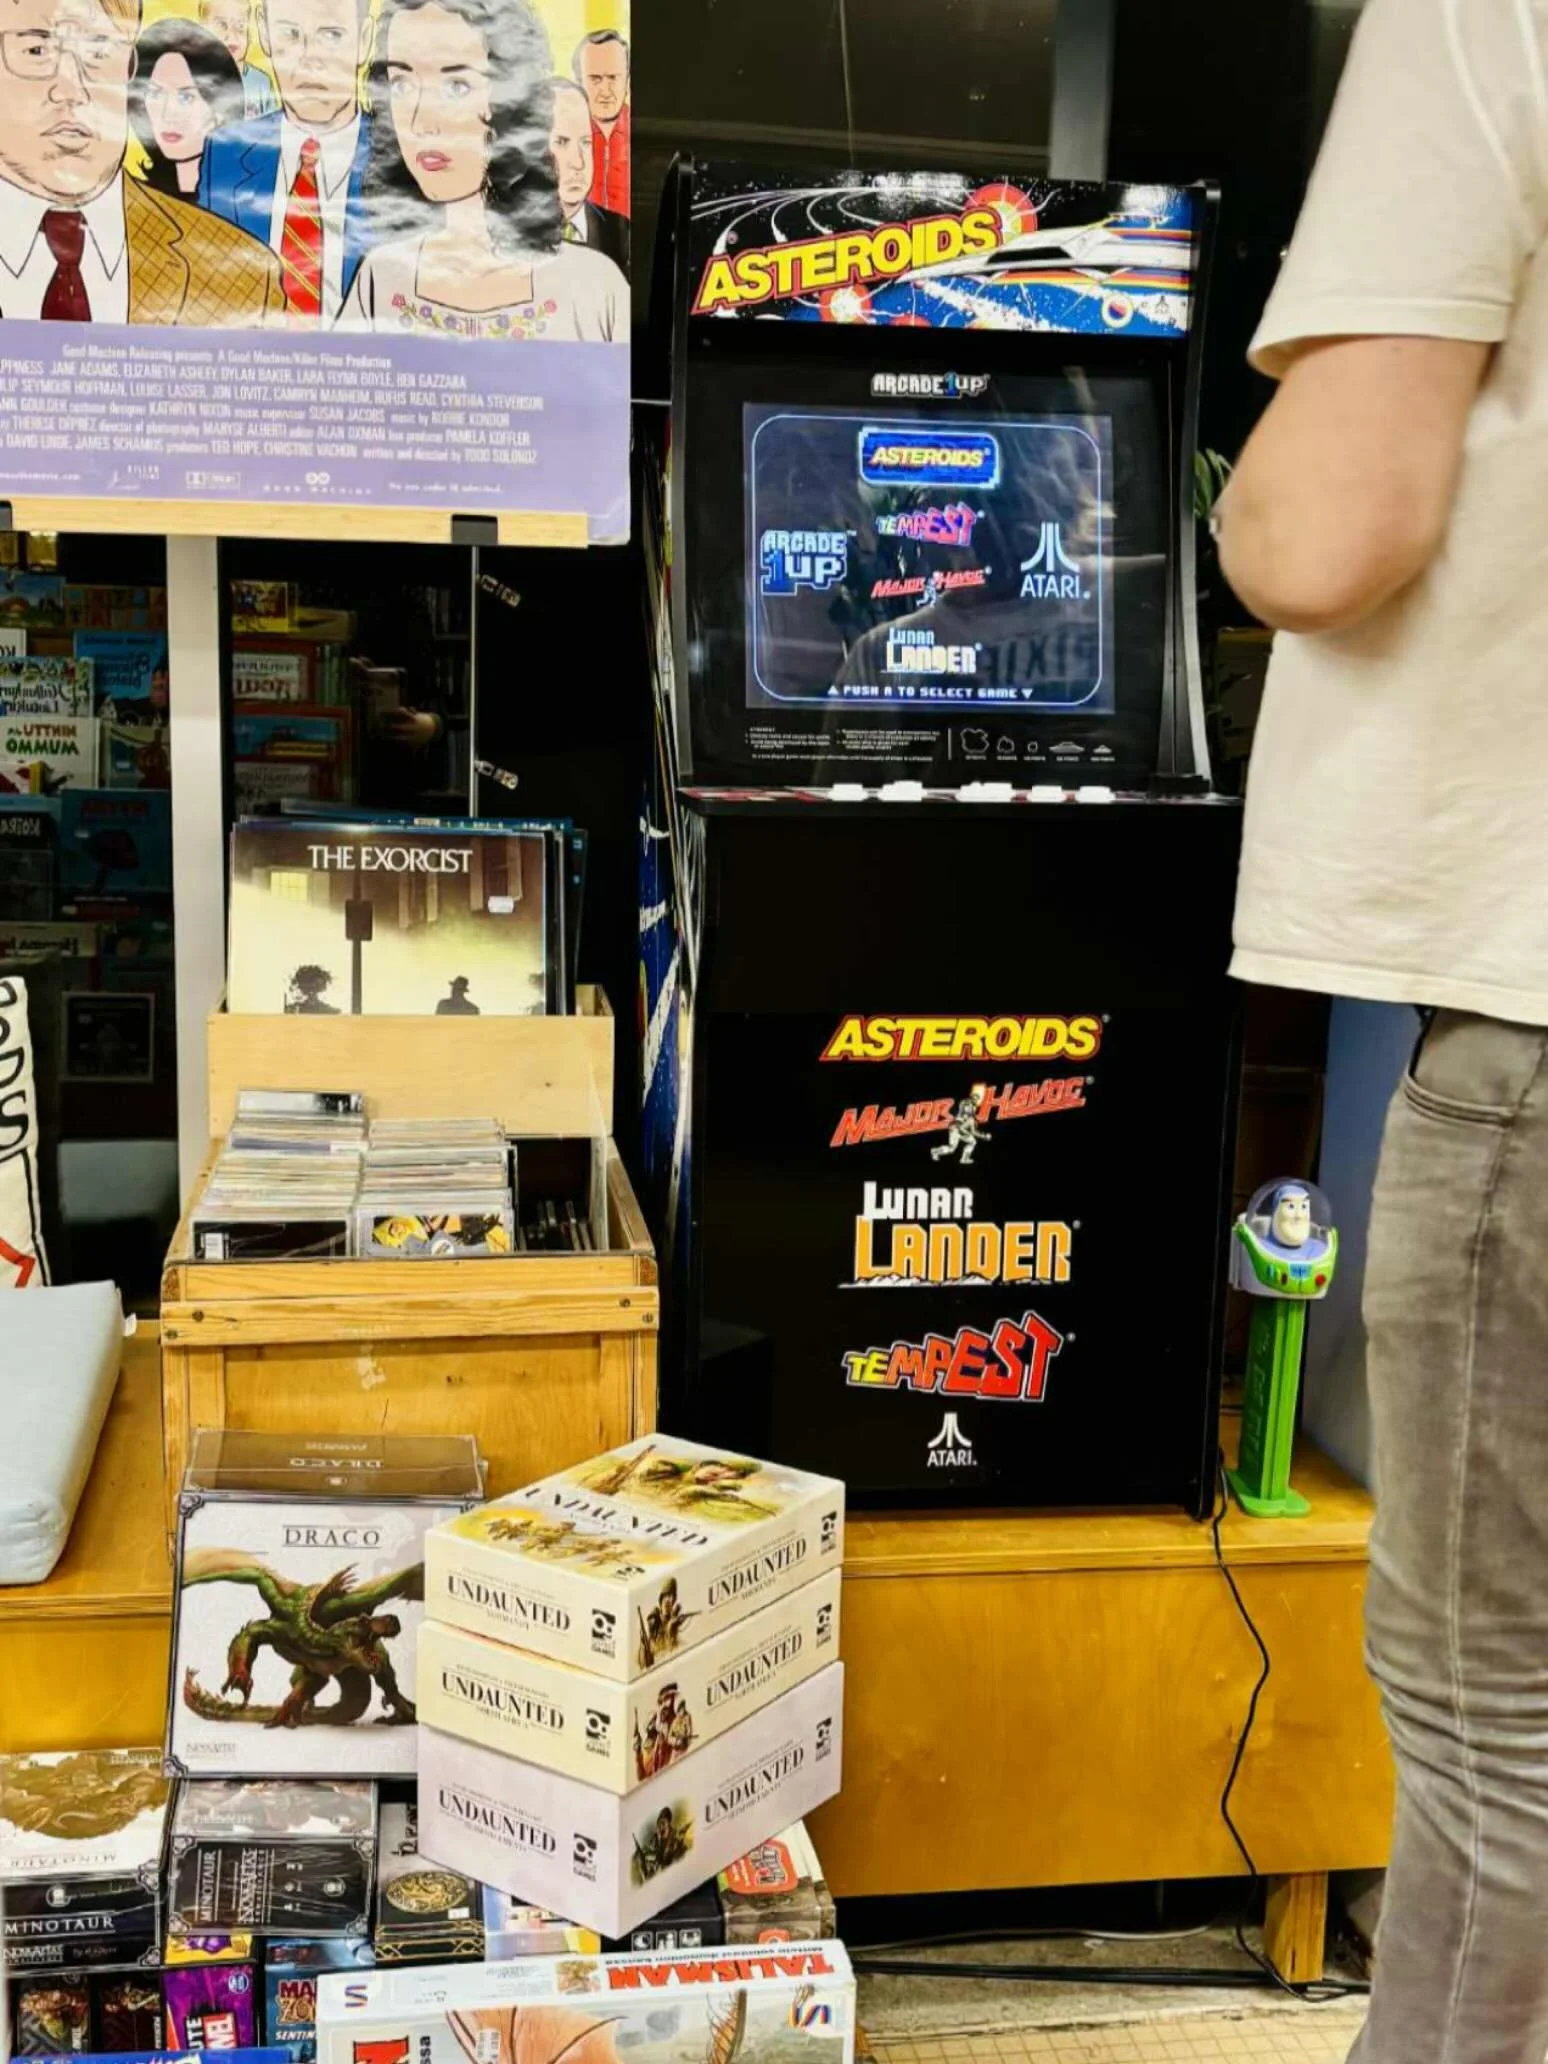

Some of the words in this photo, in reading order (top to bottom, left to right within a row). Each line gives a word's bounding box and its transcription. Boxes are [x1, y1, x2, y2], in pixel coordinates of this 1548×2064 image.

[694, 206, 1001, 313] ASTEROIDS
[20, 379, 72, 394] SEYMOUR
[130, 382, 164, 396] LOUISE
[212, 385, 232, 399] JON
[52, 361, 77, 375] JANE
[124, 364, 176, 378] ELIZABETH
[220, 366, 256, 381] DYLAN
[296, 370, 325, 384] LARA
[418, 374, 467, 389] GAZZARA
[308, 404, 344, 420] SUSAN
[346, 407, 385, 422] JACOBS
[6, 433, 38, 448] DAVID
[75, 434, 111, 450] JAMES
[316, 424, 344, 439] ALAN
[445, 428, 486, 444] PAMELA
[488, 430, 530, 446] KOFFLER
[868, 445, 984, 467] ASTEROIDS
[876, 502, 977, 548] TEMPEST
[762, 529, 849, 553] ARCADE
[761, 550, 846, 596] 1UP
[1020, 573, 1082, 599] ATARI
[886, 641, 977, 675] LANDER
[843, 685, 879, 696] PUSH
[898, 686, 915, 697] TO
[919, 686, 973, 698] SELECT
[977, 688, 1018, 699] GAME
[307, 844, 355, 871] THE
[360, 846, 474, 873] EXORCIST
[819, 1014, 1103, 1062] ASTEROIDS
[863, 1180, 975, 1221] LUNAR
[854, 1214, 1074, 1283] LANDER
[841, 1310, 1065, 1403] TEMPEST
[290, 1457, 384, 1469] DRACO
[927, 1449, 973, 1467] ATARI
[524, 1486, 709, 1547] UNDAUNTED
[285, 1527, 380, 1546] DRACO
[708, 1537, 808, 1607] UNDAUNTED
[447, 1574, 571, 1633] UNDAUNTED
[706, 1632, 803, 1706] UNDAUNTED
[441, 1671, 565, 1731] UNDAUNTED
[704, 1746, 805, 1824] UNDAUNTED
[440, 1787, 557, 1854] UNDAUNTED
[201, 1850, 216, 1922] MINOTAUR
[4, 1915, 116, 1935] MINOTAUR
[607, 1953, 835, 1991] TALISMAN
[279, 1979, 316, 1998] MA
[277, 1996, 316, 2024] ZO
[275, 2030, 317, 2041] SENTIN
